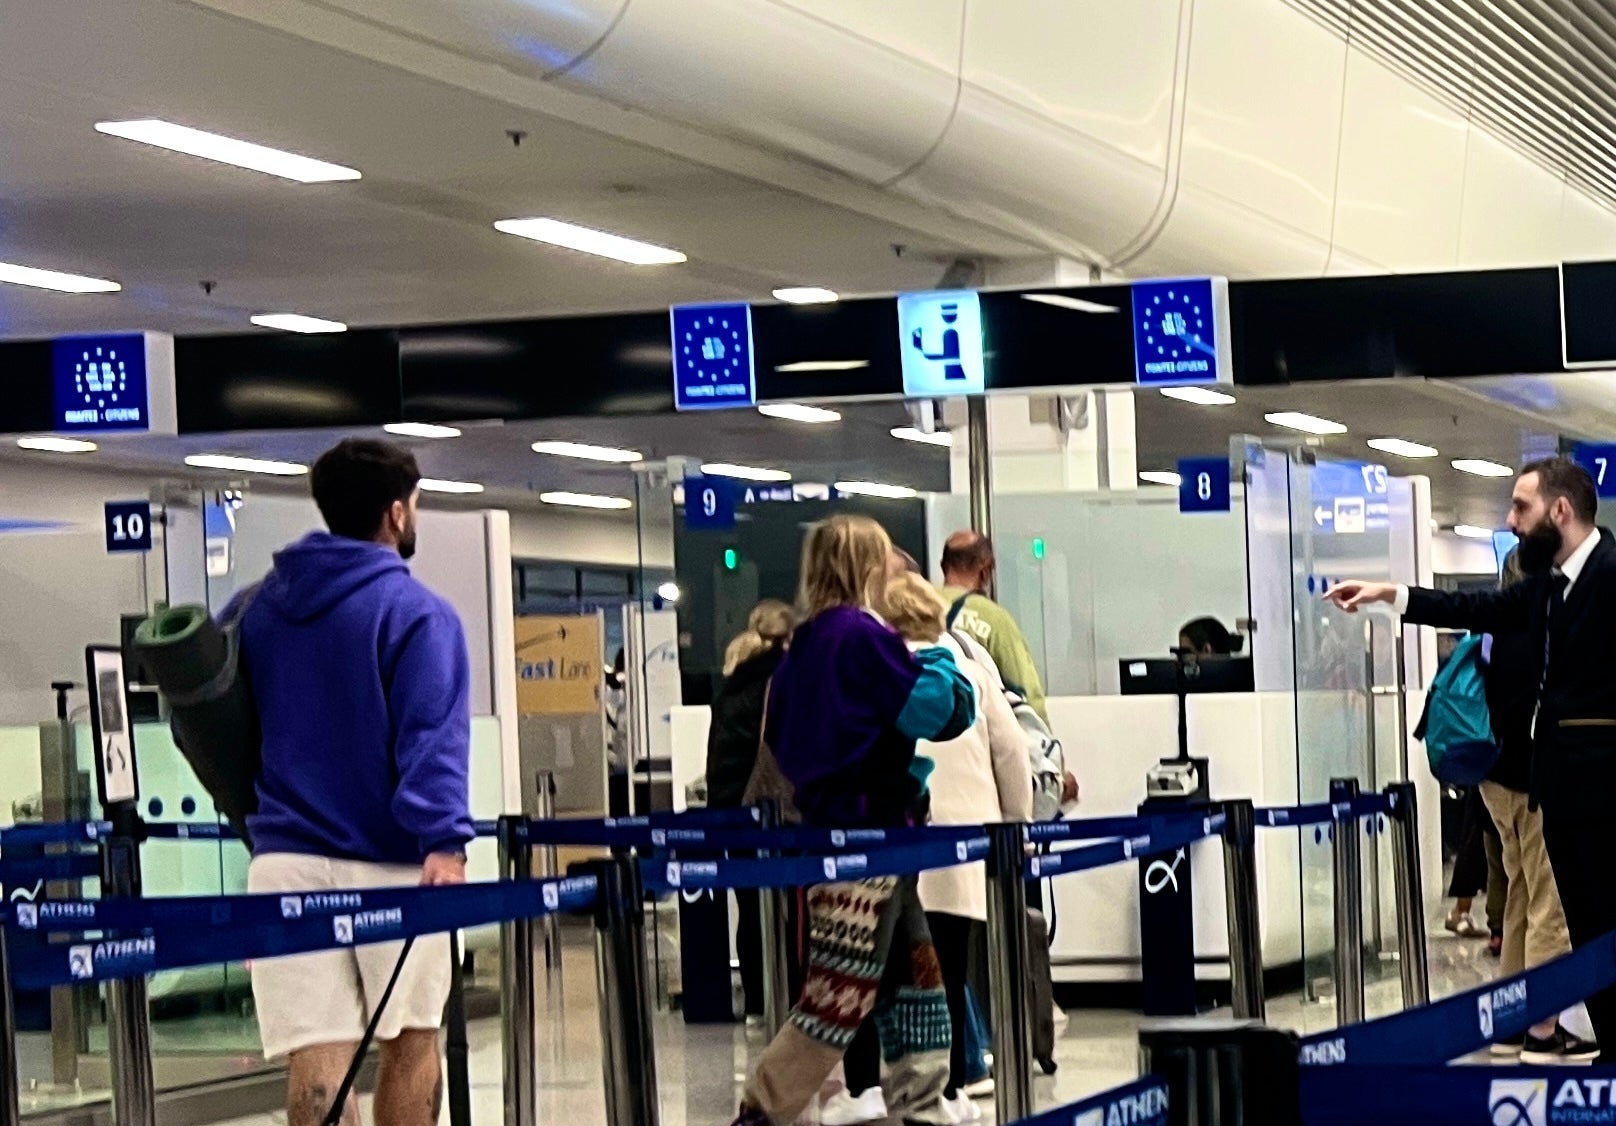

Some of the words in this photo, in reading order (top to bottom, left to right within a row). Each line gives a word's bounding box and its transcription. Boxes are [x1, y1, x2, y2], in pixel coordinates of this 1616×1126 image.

[1198, 471, 1211, 500] 8
[1595, 458, 1607, 486] 7
[702, 488, 716, 516] 9
[112, 514, 144, 541] 10
[94, 936, 156, 962] ATHENS
[1299, 1037, 1346, 1065] THENS
